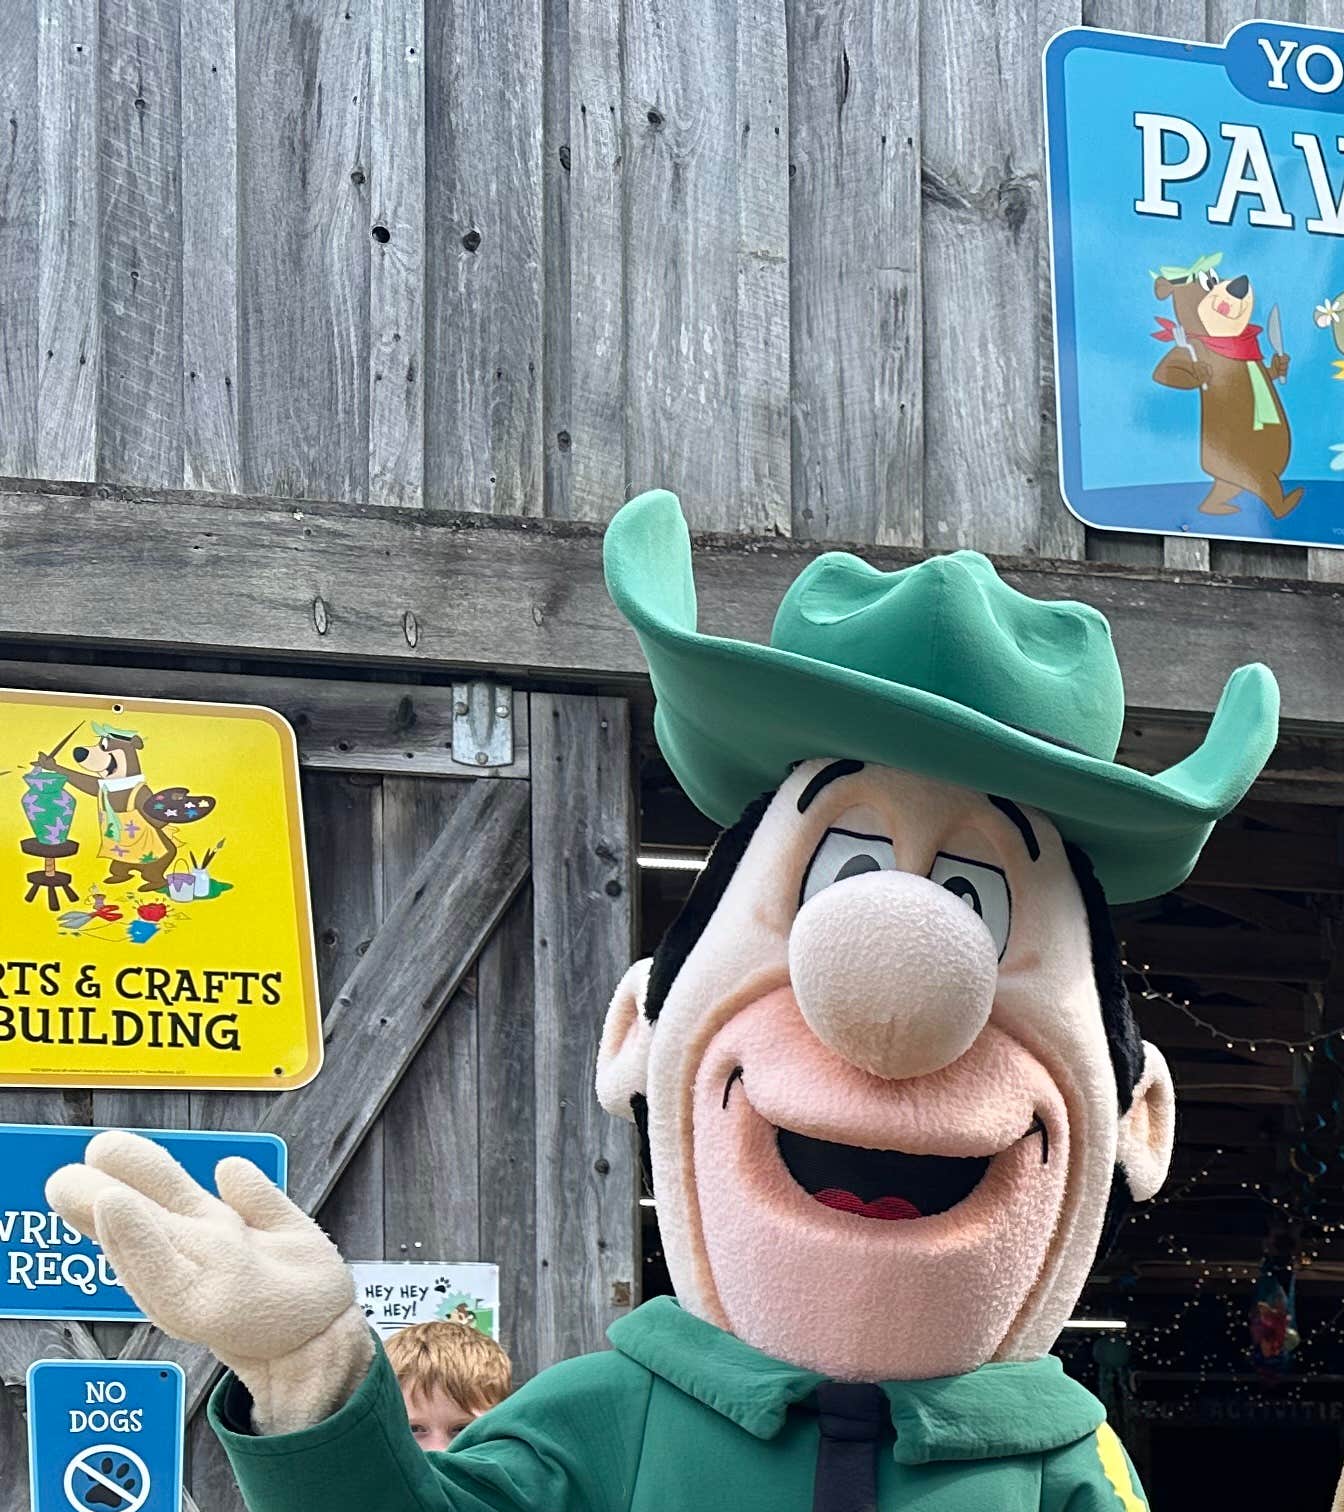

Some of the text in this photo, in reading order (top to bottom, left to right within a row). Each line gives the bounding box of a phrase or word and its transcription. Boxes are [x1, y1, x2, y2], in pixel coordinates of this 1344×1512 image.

[75, 964, 101, 999] &
[115, 966, 282, 1006] CRAFTS
[365, 1285, 429, 1301] HEY HEY
[383, 1301, 417, 1320] HEY!
[85, 1381, 127, 1404] NO
[69, 1408, 143, 1432] DOGS
